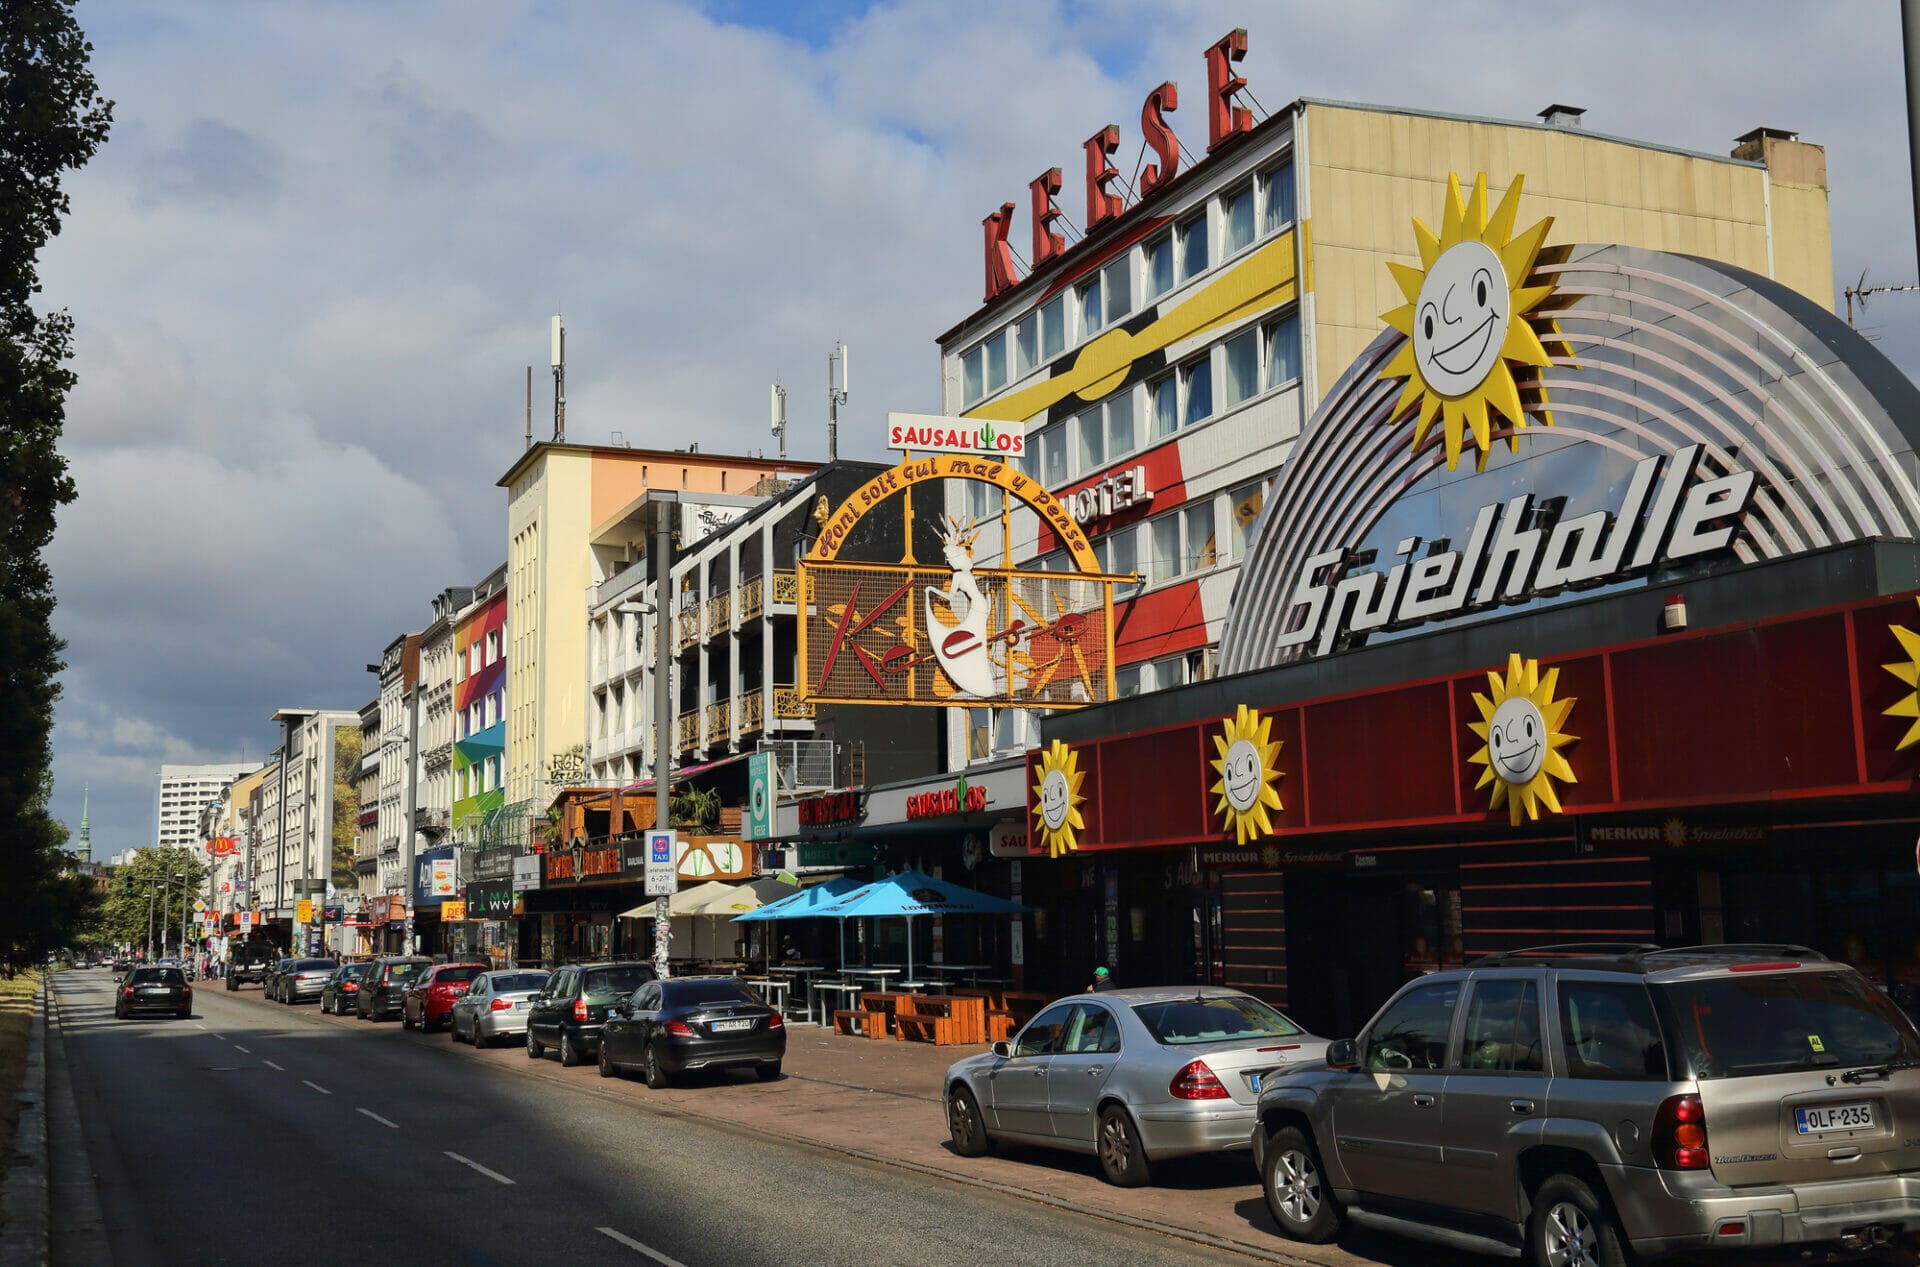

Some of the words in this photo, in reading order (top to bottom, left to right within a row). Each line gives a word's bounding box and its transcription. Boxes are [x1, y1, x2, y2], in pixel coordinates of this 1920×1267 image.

[982, 27, 1253, 304] KEESE
[820, 502, 860, 557] Honi
[861, 470, 897, 506] soit
[950, 460, 1002, 479] mal
[1012, 475, 1027, 491] y
[1033, 491, 1085, 552] pense
[1277, 443, 1757, 656] Spielhalle
[1203, 851, 1259, 864] MERKUR
[1592, 826, 1660, 841] MERKUR
